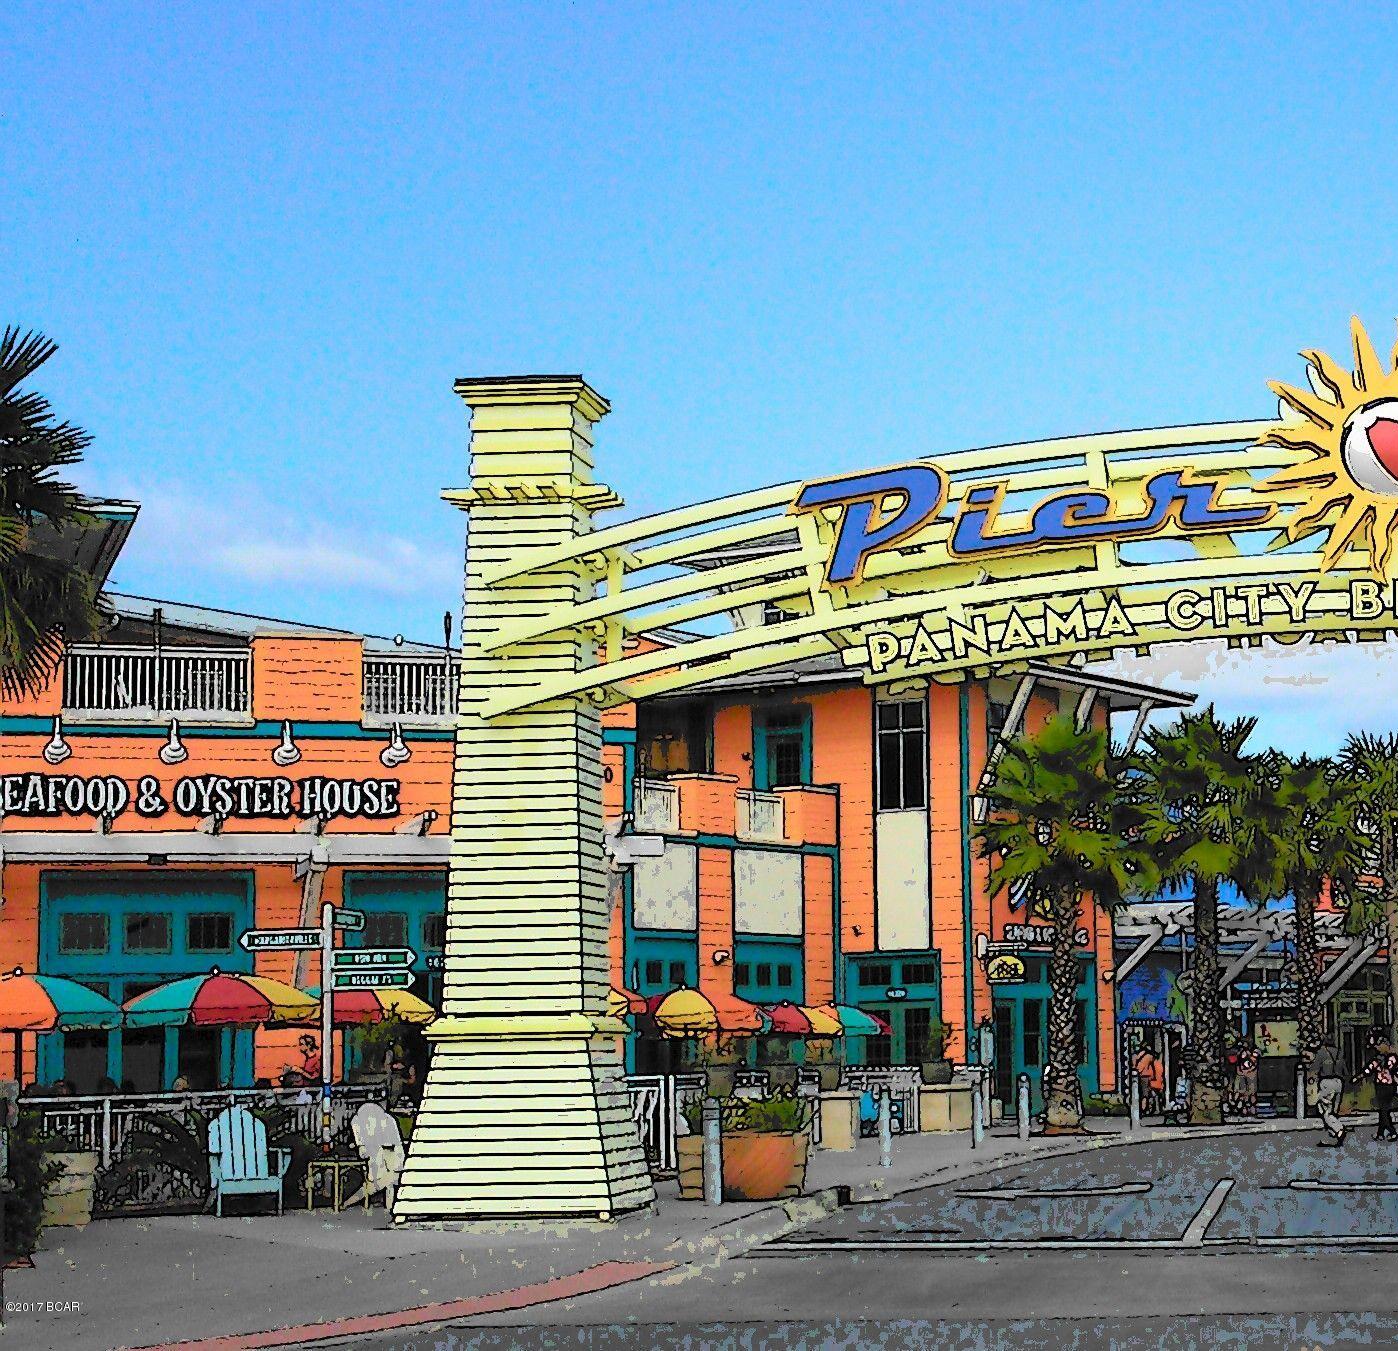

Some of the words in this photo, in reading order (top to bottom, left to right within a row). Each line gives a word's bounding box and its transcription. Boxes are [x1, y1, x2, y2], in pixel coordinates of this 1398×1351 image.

[798, 463, 1279, 586] Pier
[867, 597, 1137, 673] PANAMA
[1166, 580, 1319, 631] CITY
[0, 774, 128, 815] EAFOOD
[138, 776, 165, 813] &
[176, 775, 291, 815] OYSTER
[302, 778, 399, 815] HOUSE
